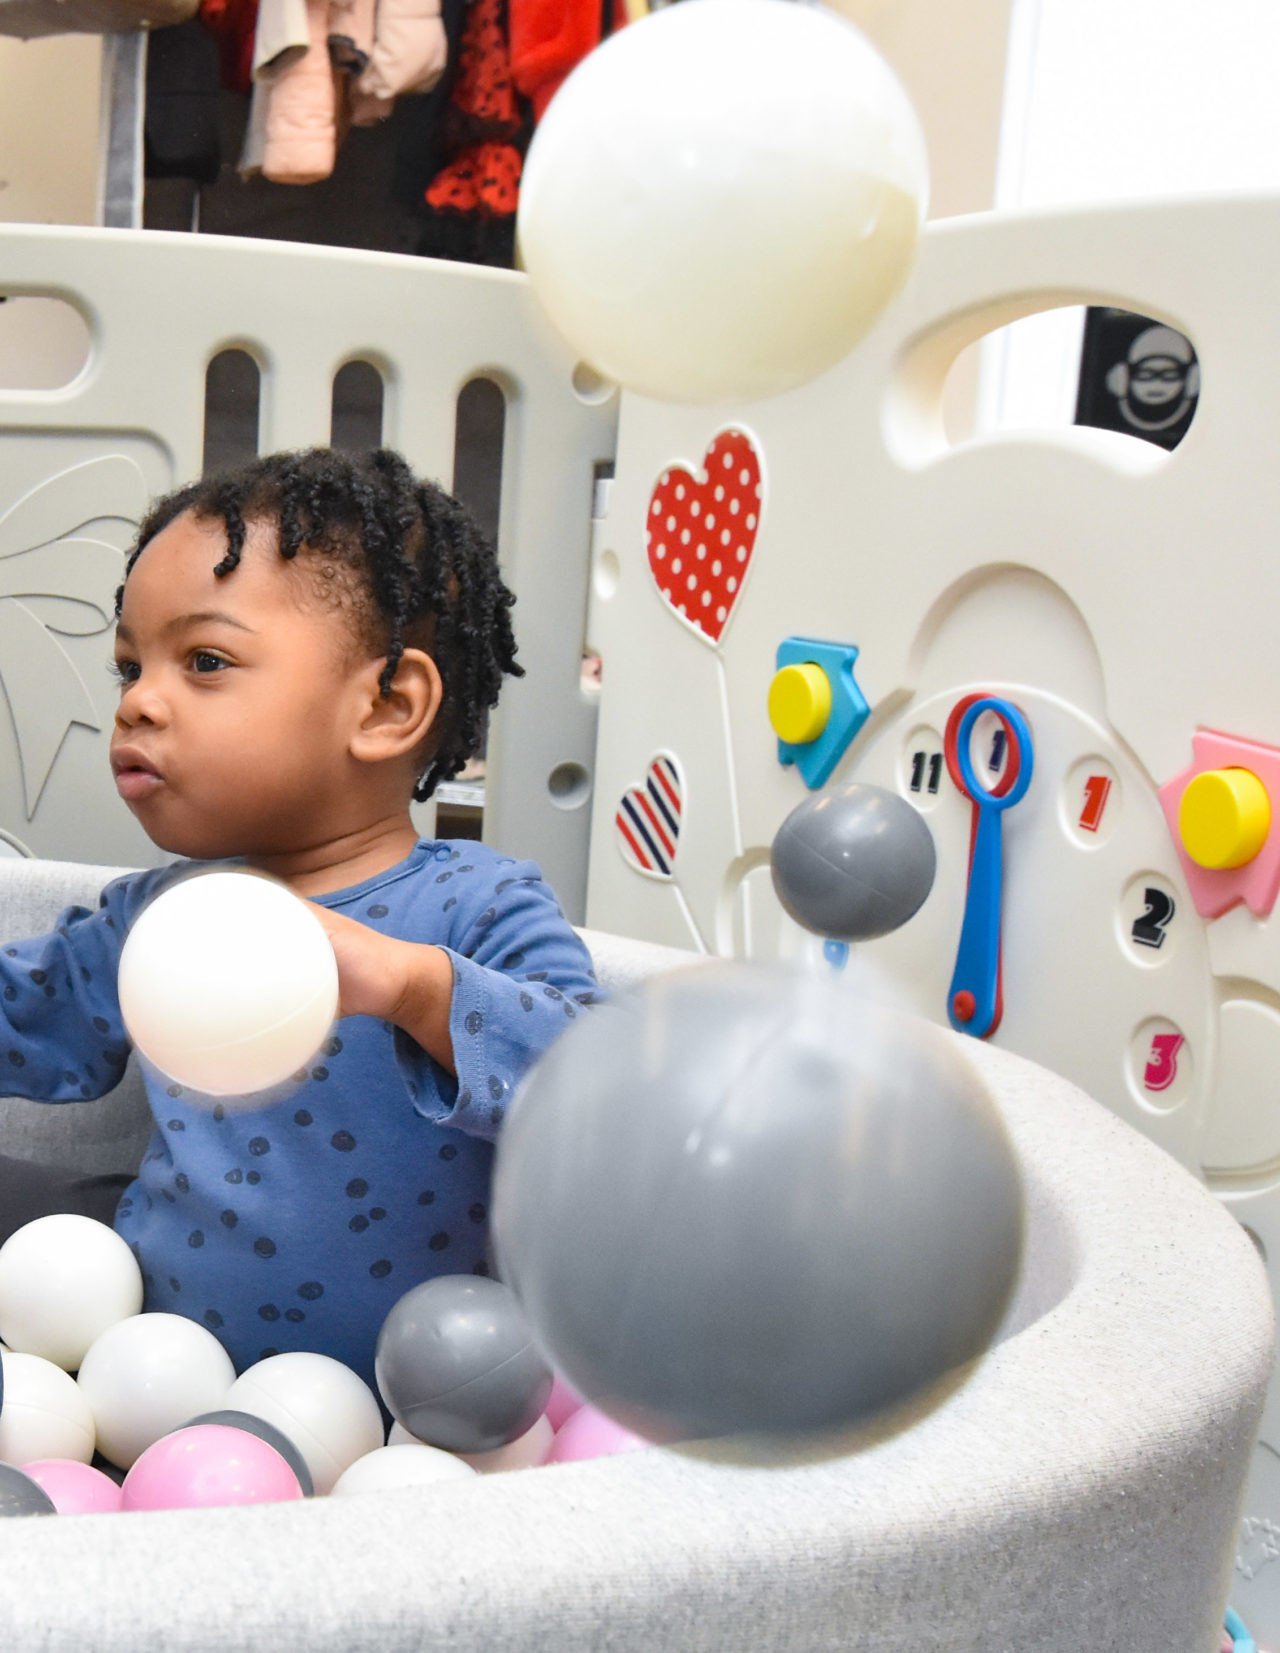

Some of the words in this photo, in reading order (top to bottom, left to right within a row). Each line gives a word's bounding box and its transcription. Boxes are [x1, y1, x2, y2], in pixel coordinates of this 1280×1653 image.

[911, 751, 942, 794] 11
[1079, 776, 1112, 832] 1
[1132, 888, 1175, 948] 2
[1144, 1034, 1185, 1091] 3
